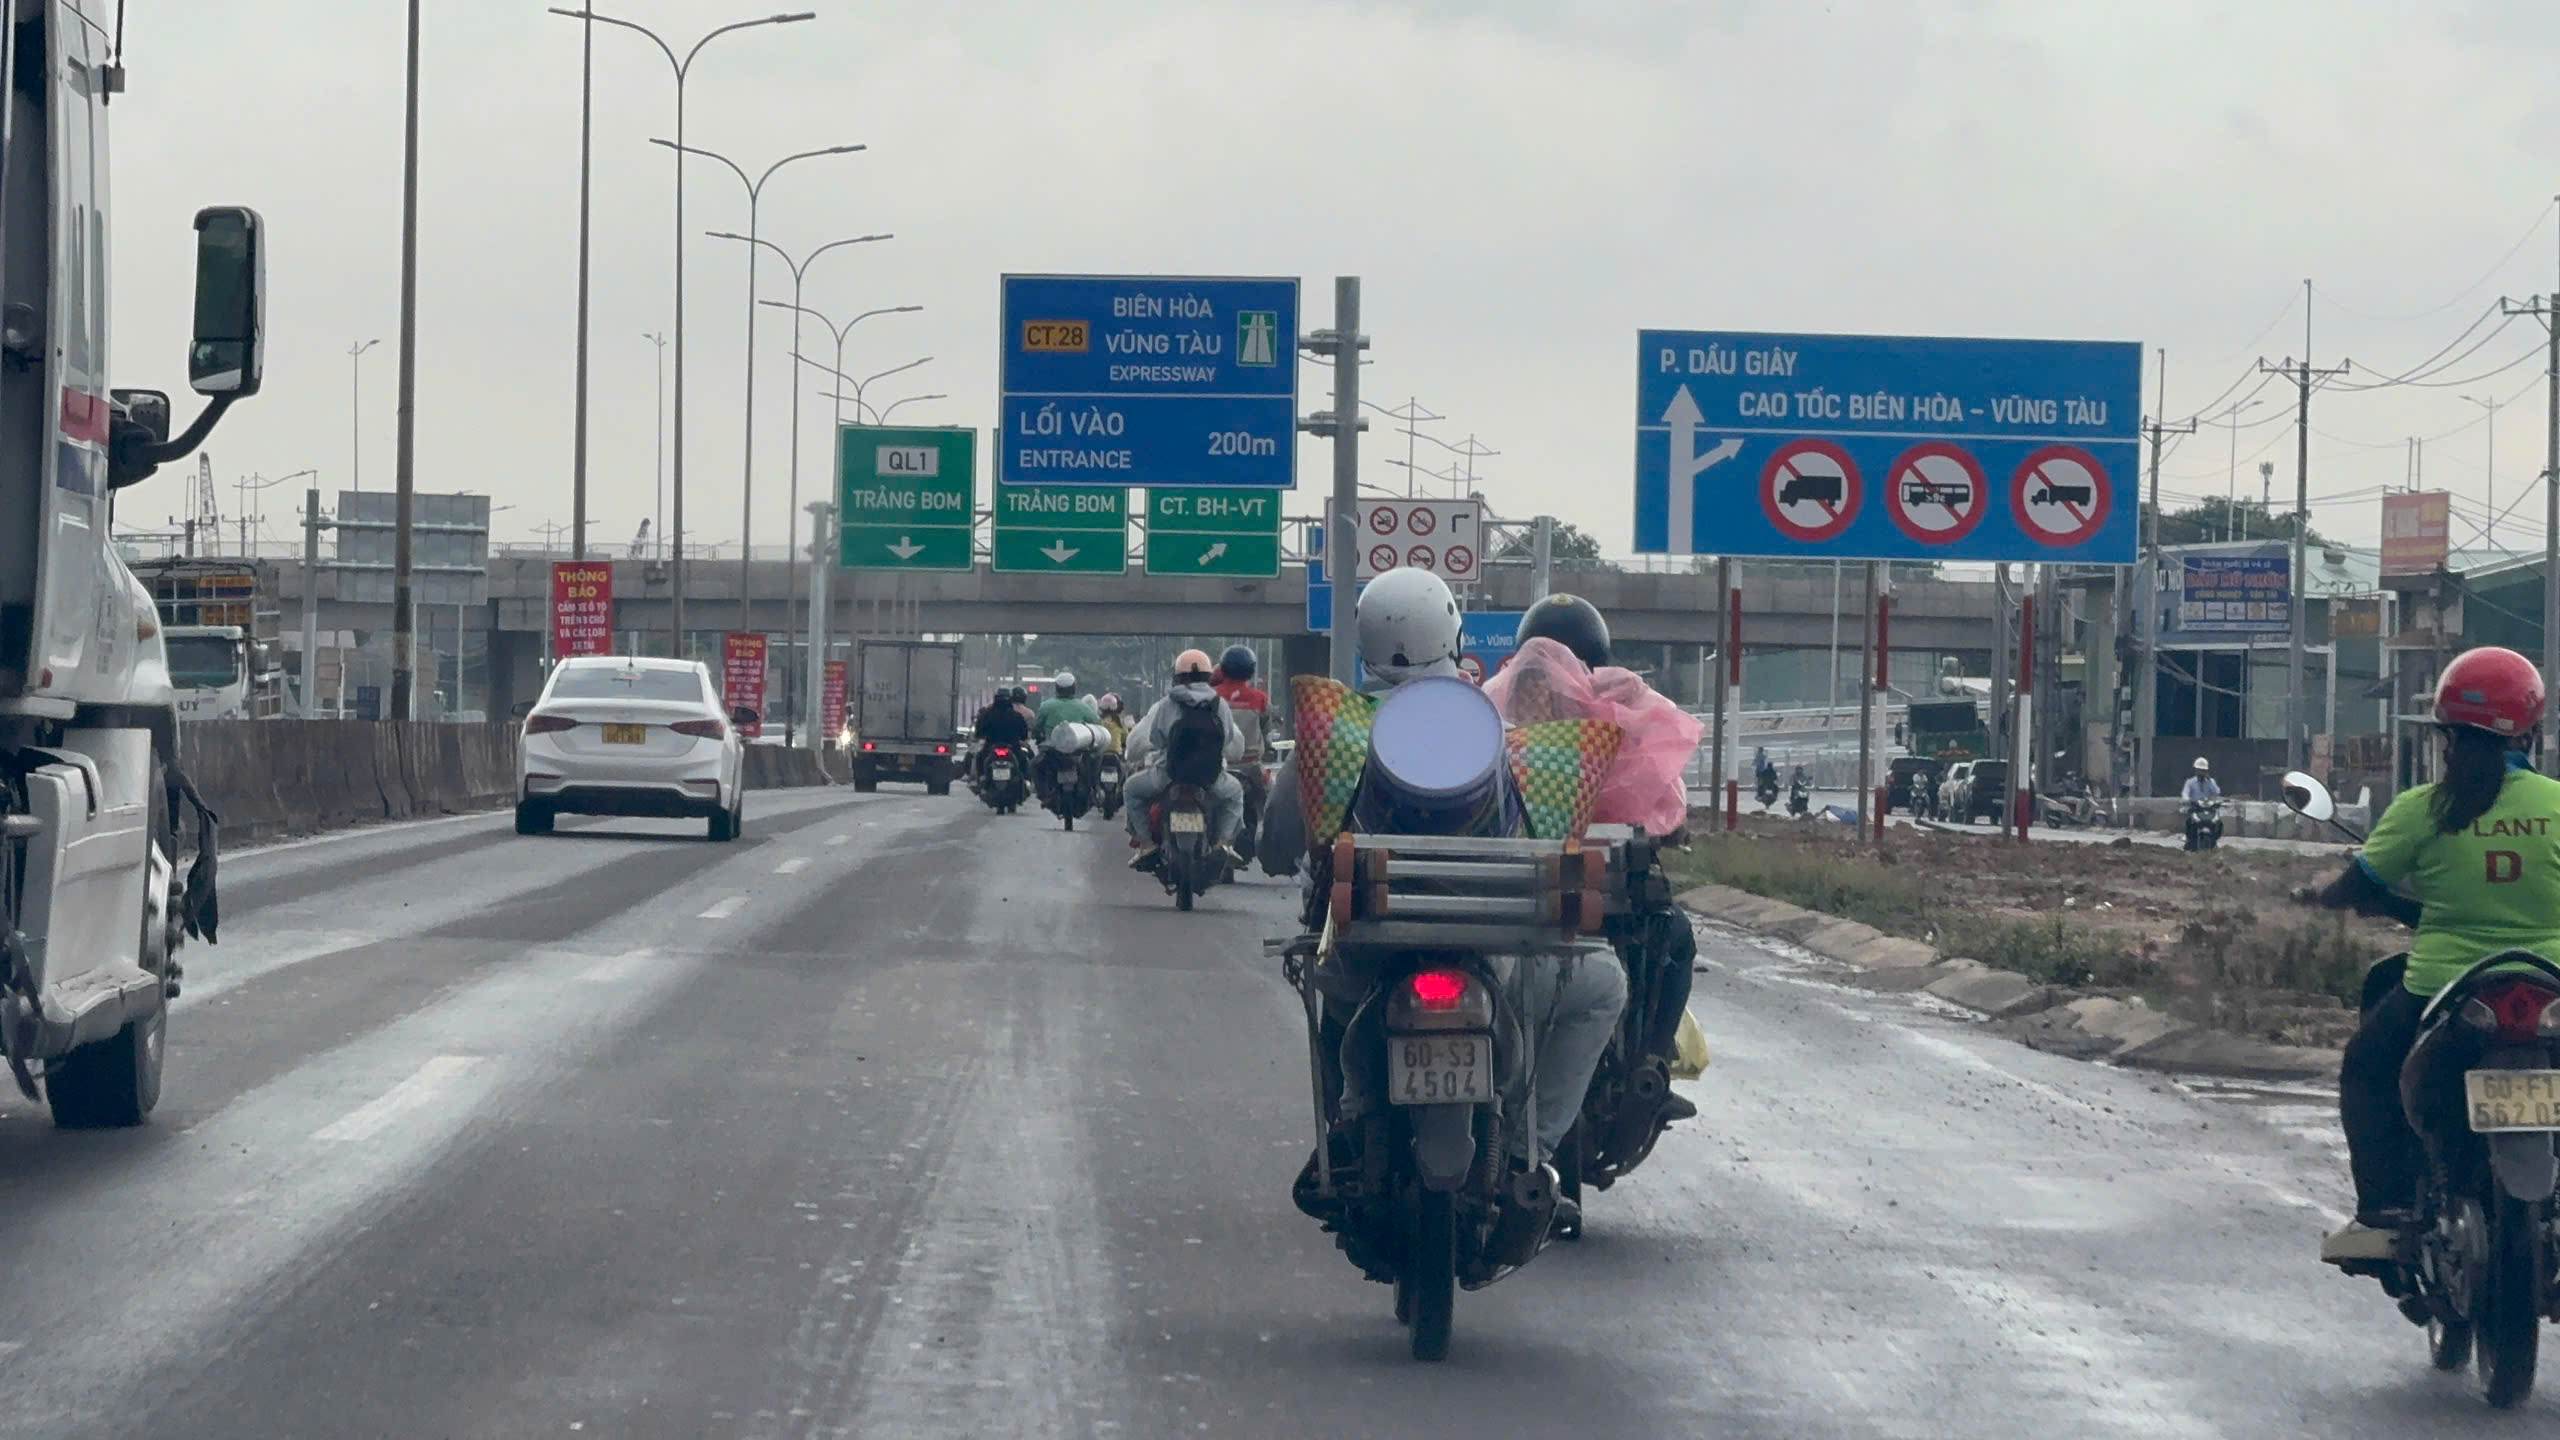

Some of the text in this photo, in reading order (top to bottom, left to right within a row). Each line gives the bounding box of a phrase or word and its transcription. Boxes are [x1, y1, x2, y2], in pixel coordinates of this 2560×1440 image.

[1113, 293, 1213, 318] BIÊN HÒA
[1027, 326, 1084, 347] CT.28
[1106, 329, 1222, 355] VŨNG TÀU
[1110, 365, 1216, 382] EXPRESSWAY
[1660, 349, 1680, 373] P.
[1745, 347, 1798, 376] GIÂY
[1739, 392, 1787, 417] CAO
[1794, 386, 1841, 418] TỐC
[1850, 391, 1904, 420] BIÊN
[1913, 392, 1964, 422] HÒA
[1991, 393, 2057, 424] VŨNG
[2064, 395, 2107, 425] TÀU
[1020, 403, 1124, 436] LỐI VÀO
[1208, 432, 1275, 456] 200m
[888, 452, 927, 471] QL1
[1020, 450, 1132, 469] ENTRANCE
[852, 484, 961, 510] TRẢNG BOM
[1007, 488, 1115, 512] TRẢNG BOM
[1160, 497, 1266, 516] CT. BH-VT
[558, 568, 608, 582] THÔNG
[568, 583, 597, 598] BÁO
[2452, 818, 2550, 837] LANT
[2486, 851, 2522, 884] D
[1403, 1041, 1475, 1068] 60-S3
[1403, 1071, 1476, 1098] 4504
